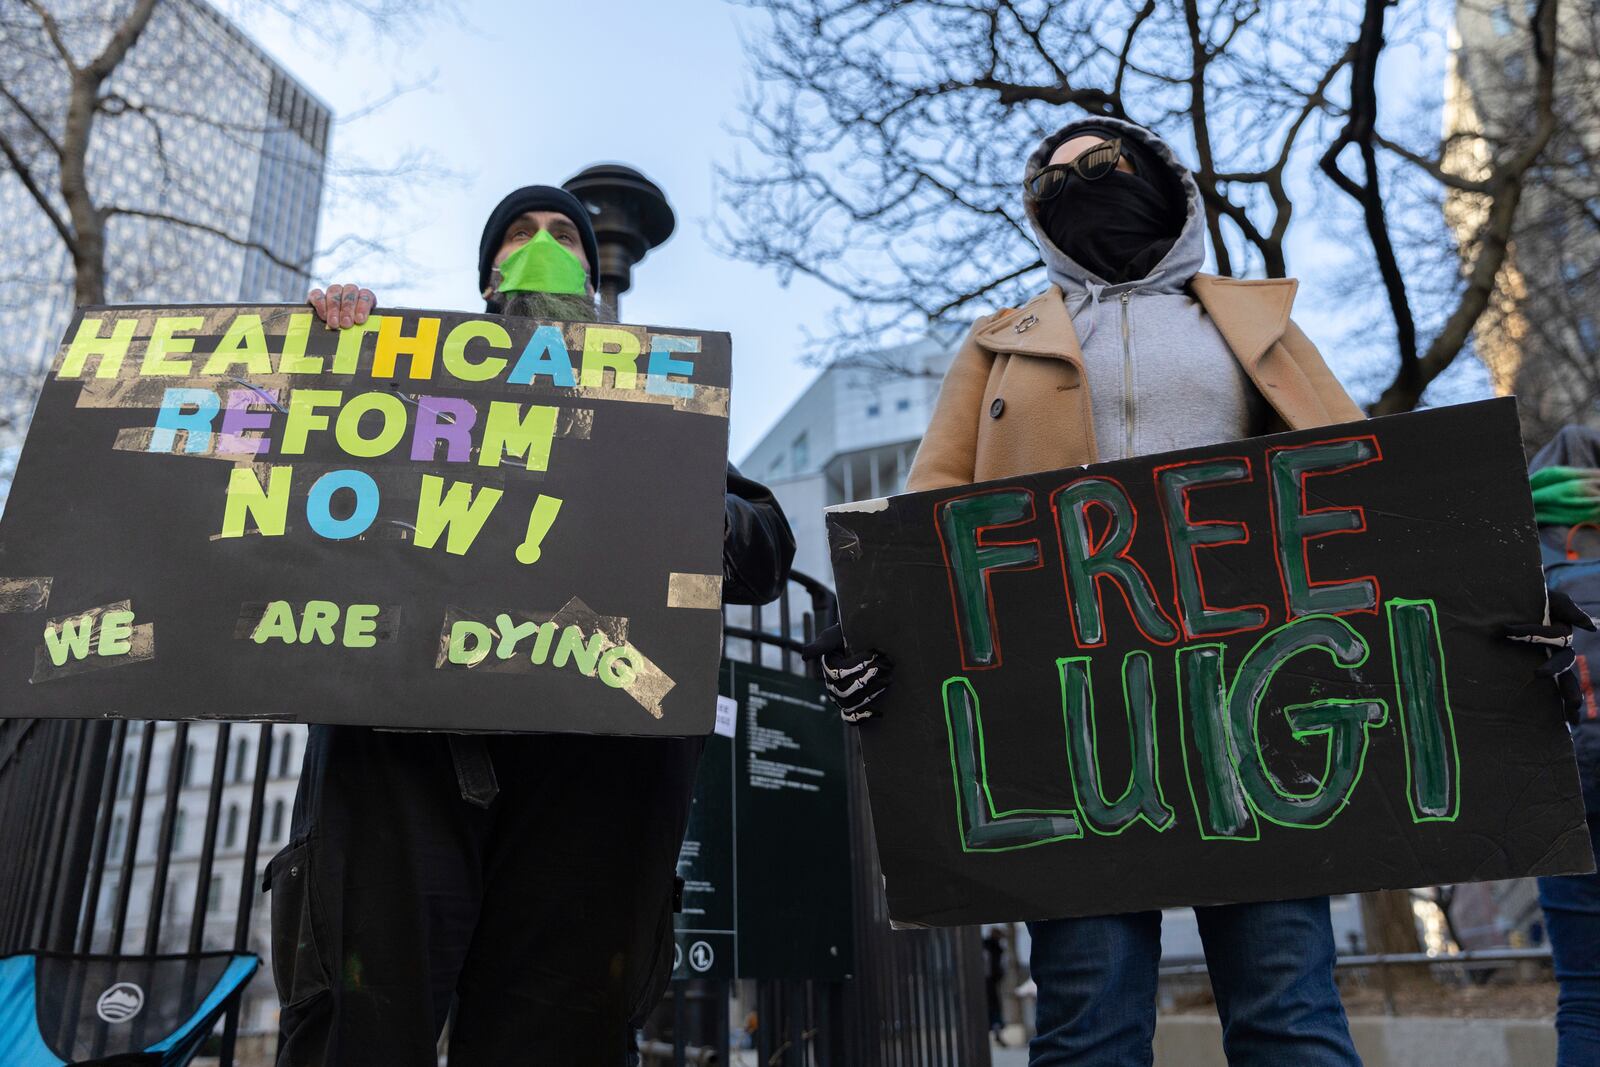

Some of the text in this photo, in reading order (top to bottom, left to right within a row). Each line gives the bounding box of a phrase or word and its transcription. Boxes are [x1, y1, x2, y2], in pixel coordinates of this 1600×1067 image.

[57, 313, 701, 399] HEALTHCARE
[147, 387, 560, 472] REFORM
[221, 466, 563, 565] NOW!
[935, 434, 1382, 670] FREE
[44, 600, 645, 689] WE ARE DYING
[943, 597, 1460, 853] LUIGI
